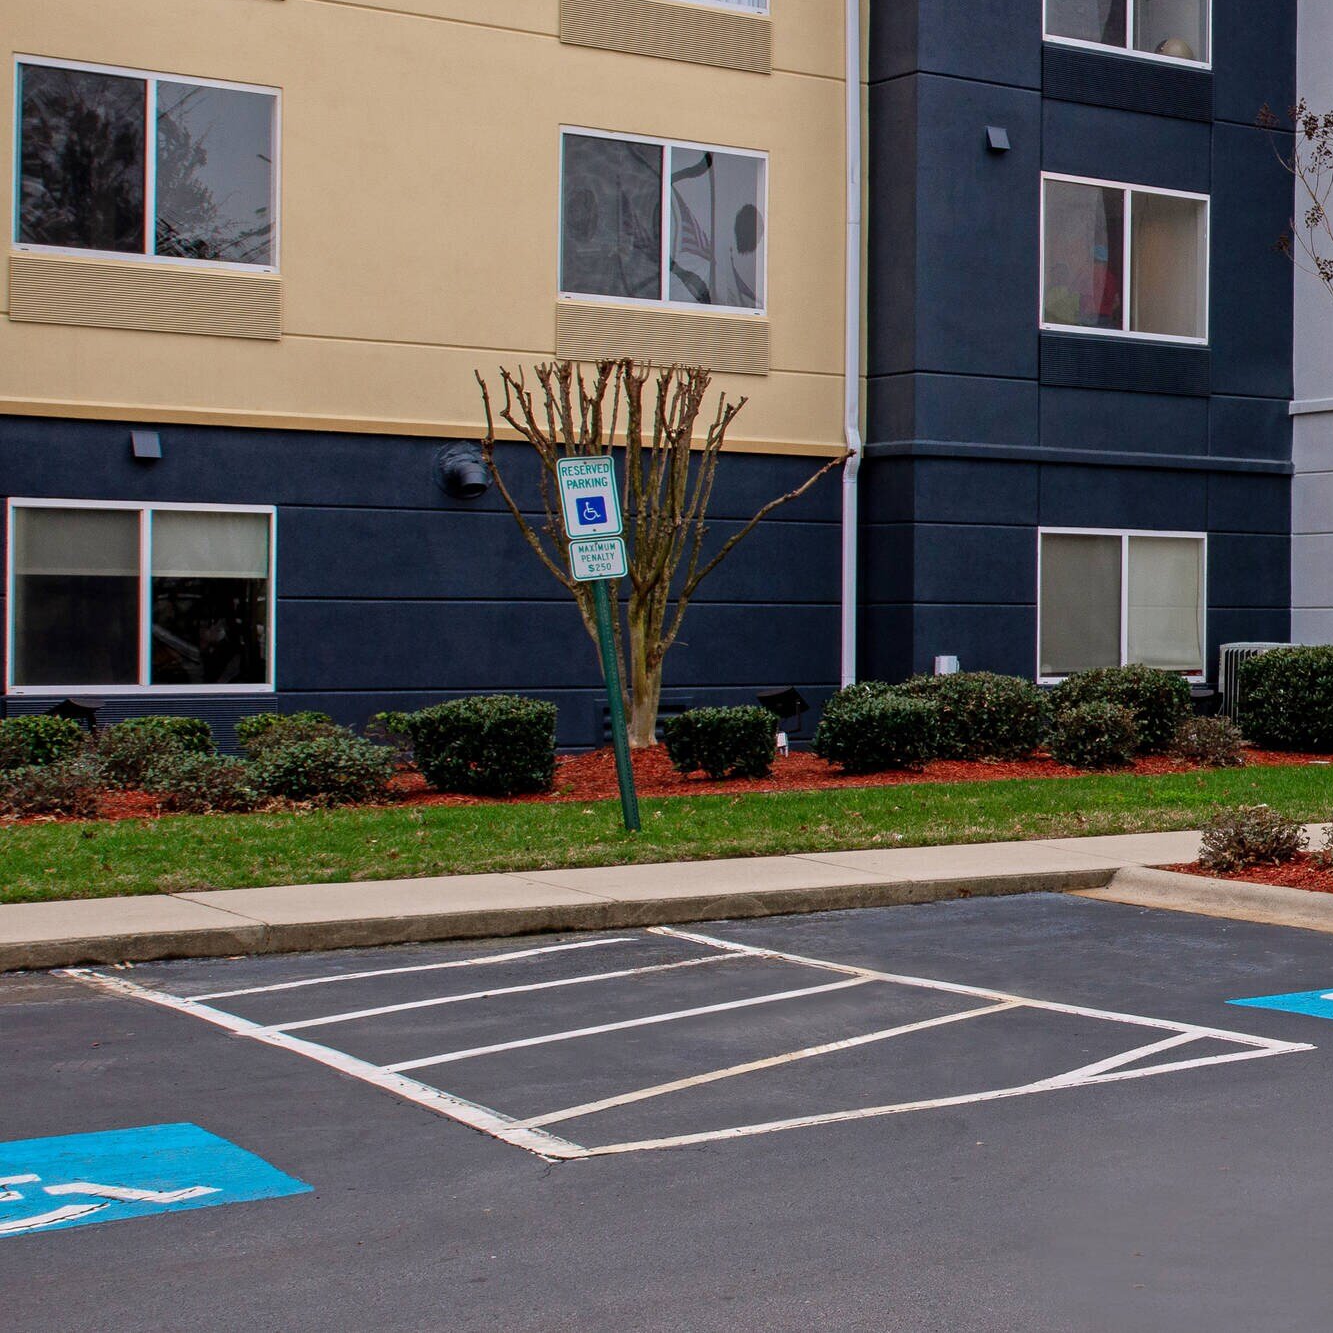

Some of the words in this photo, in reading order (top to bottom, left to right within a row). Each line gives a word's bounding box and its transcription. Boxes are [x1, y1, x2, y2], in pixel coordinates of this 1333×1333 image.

[561, 463, 609, 476] RESERVED
[566, 477, 608, 490] PARKING
[578, 542, 616, 553] MAXIMUM
[581, 552, 615, 562] PENALTY
[588, 562, 612, 573] $250
